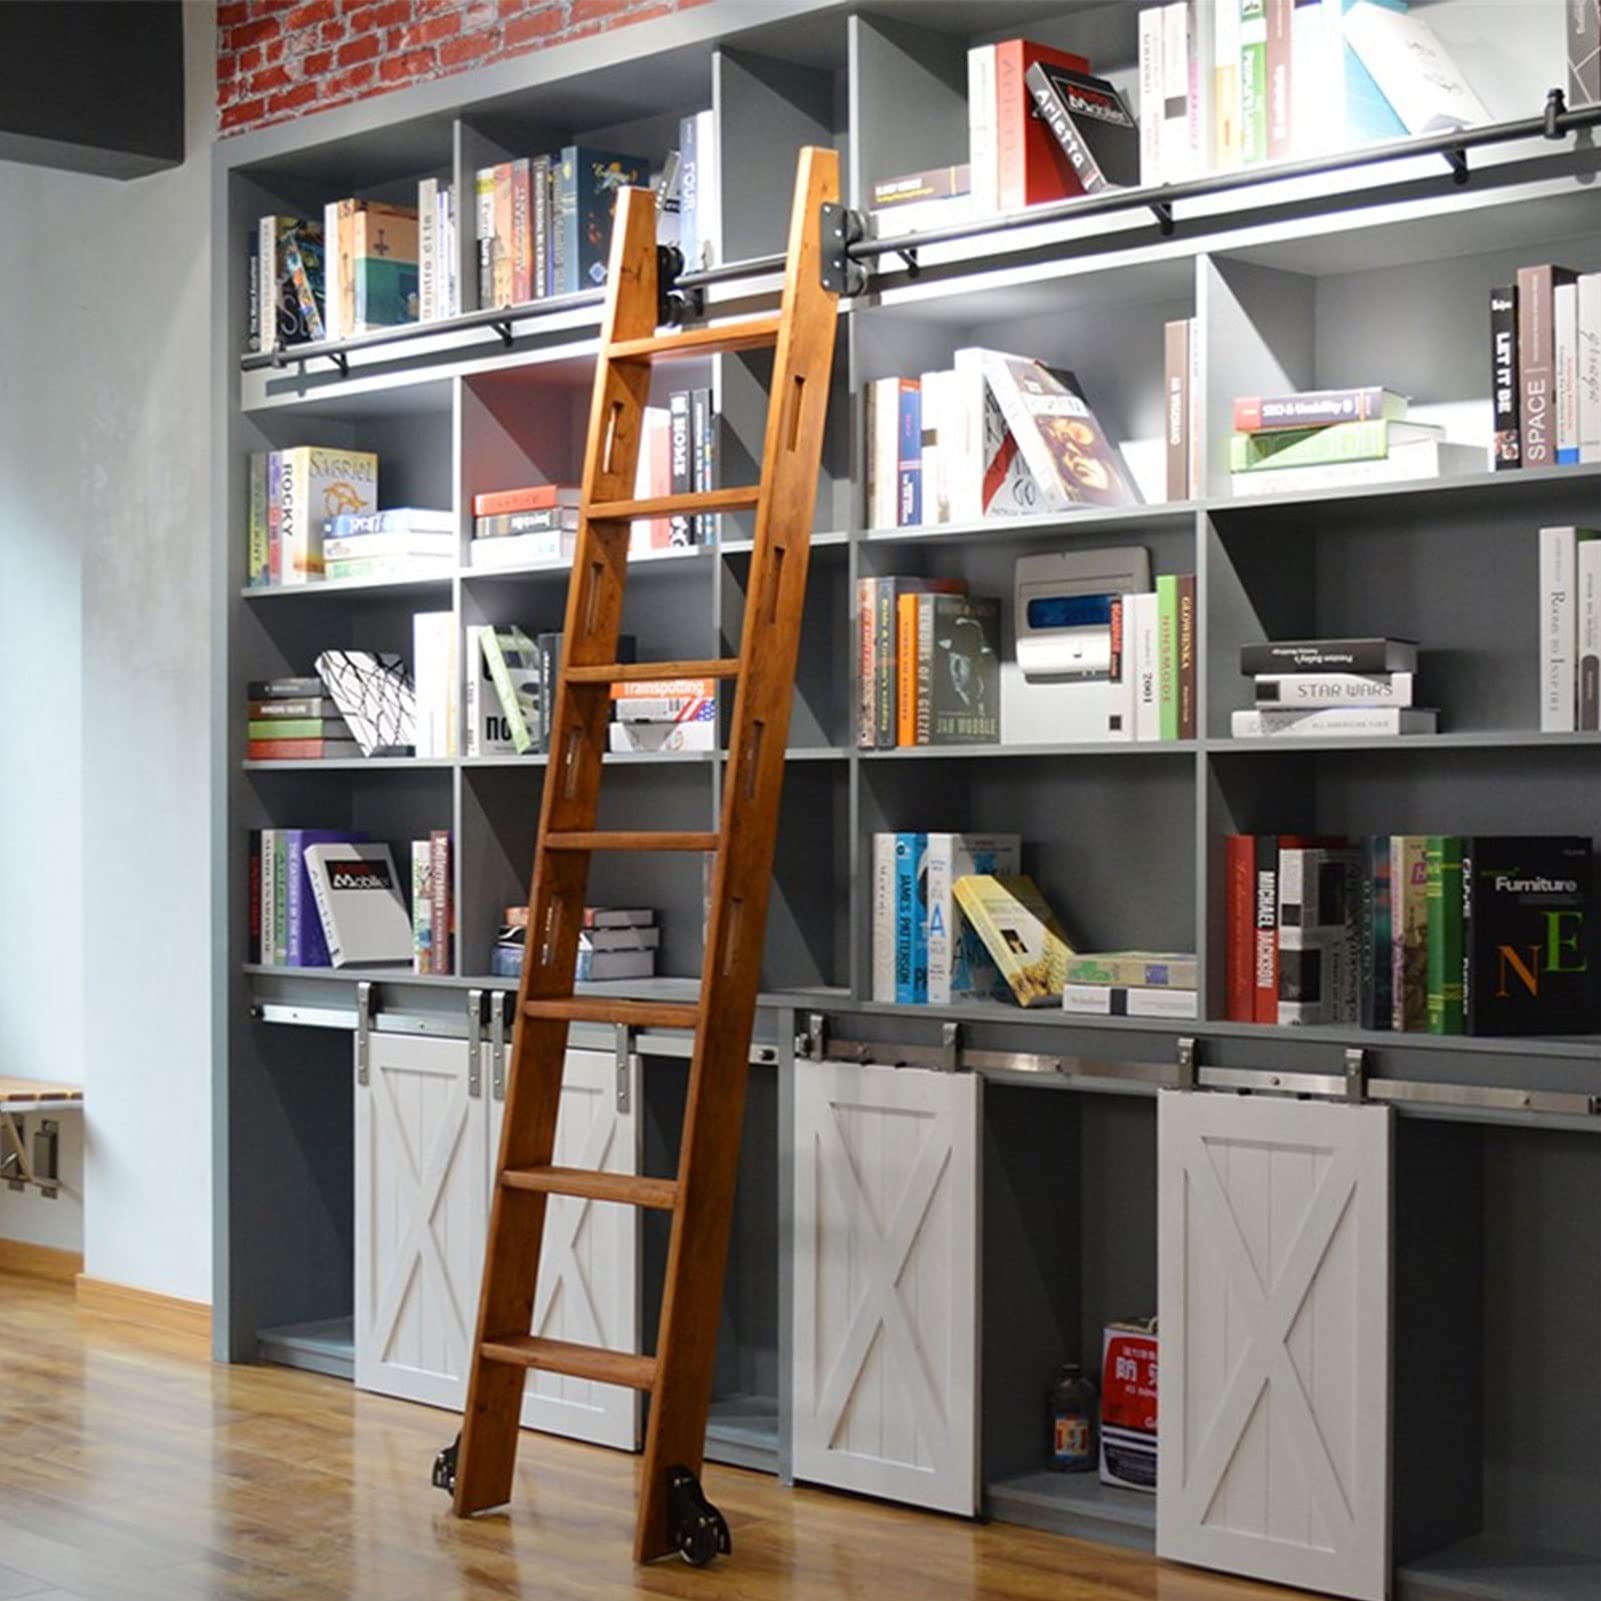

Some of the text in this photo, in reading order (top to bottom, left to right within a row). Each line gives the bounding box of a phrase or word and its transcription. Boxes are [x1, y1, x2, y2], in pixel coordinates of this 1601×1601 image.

[1034, 87, 1084, 169] Arletta
[1496, 331, 1512, 414] LET IT BE
[1527, 380, 1546, 461] SPACE
[282, 463, 294, 537] ROCKY
[1142, 671, 1153, 704] 2001
[1296, 682, 1394, 698] STAR WARS
[917, 698, 931, 744] GEEZER
[899, 874, 912, 912] JAMES
[1494, 875, 1578, 893] Furniture
[1256, 870, 1275, 989] MICHAEL JACKSON
[1541, 911, 1589, 973] E
[1496, 944, 1542, 998] N
